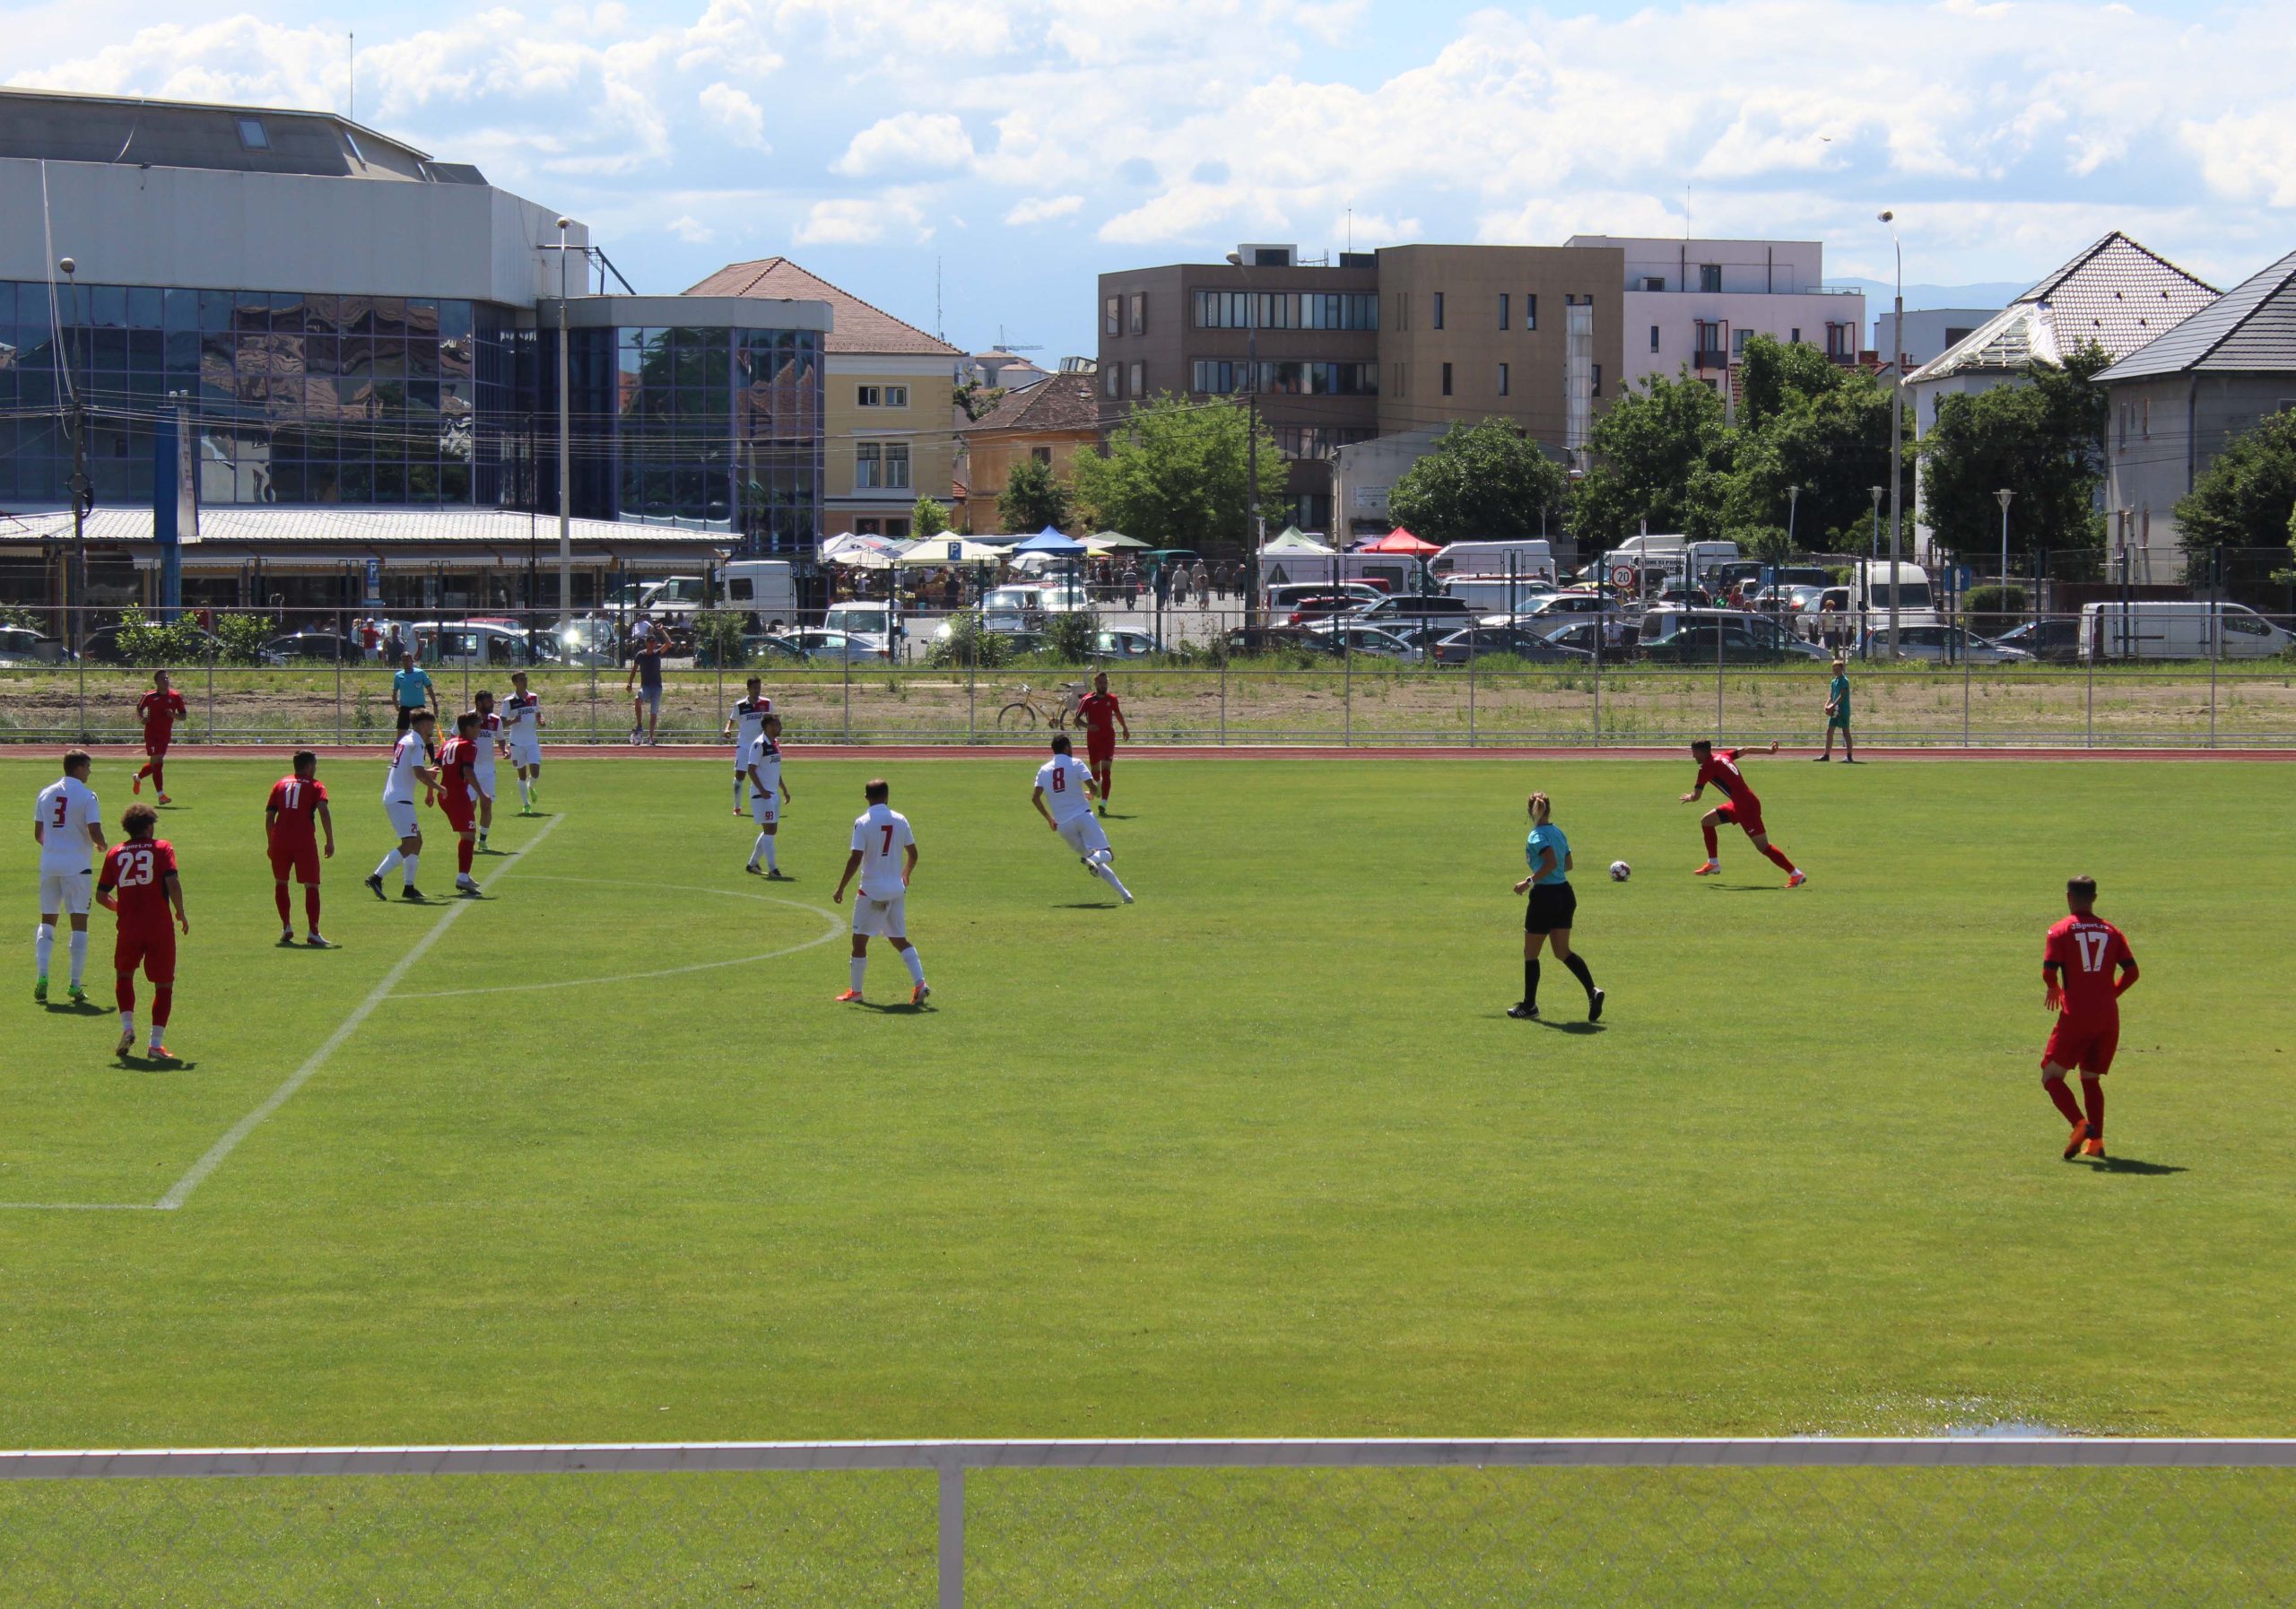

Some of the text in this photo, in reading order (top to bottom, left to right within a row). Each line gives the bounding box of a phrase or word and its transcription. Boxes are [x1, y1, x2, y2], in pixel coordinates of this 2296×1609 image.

[951, 544, 959, 555] P
[370, 562, 377, 578] P
[1618, 571, 1630, 582] 20
[1052, 767, 1065, 793] 8
[285, 782, 301, 809] 11
[52, 796, 67, 828] 3
[881, 824, 893, 857] 7
[117, 850, 154, 887] 23
[2074, 931, 2109, 972] 17
